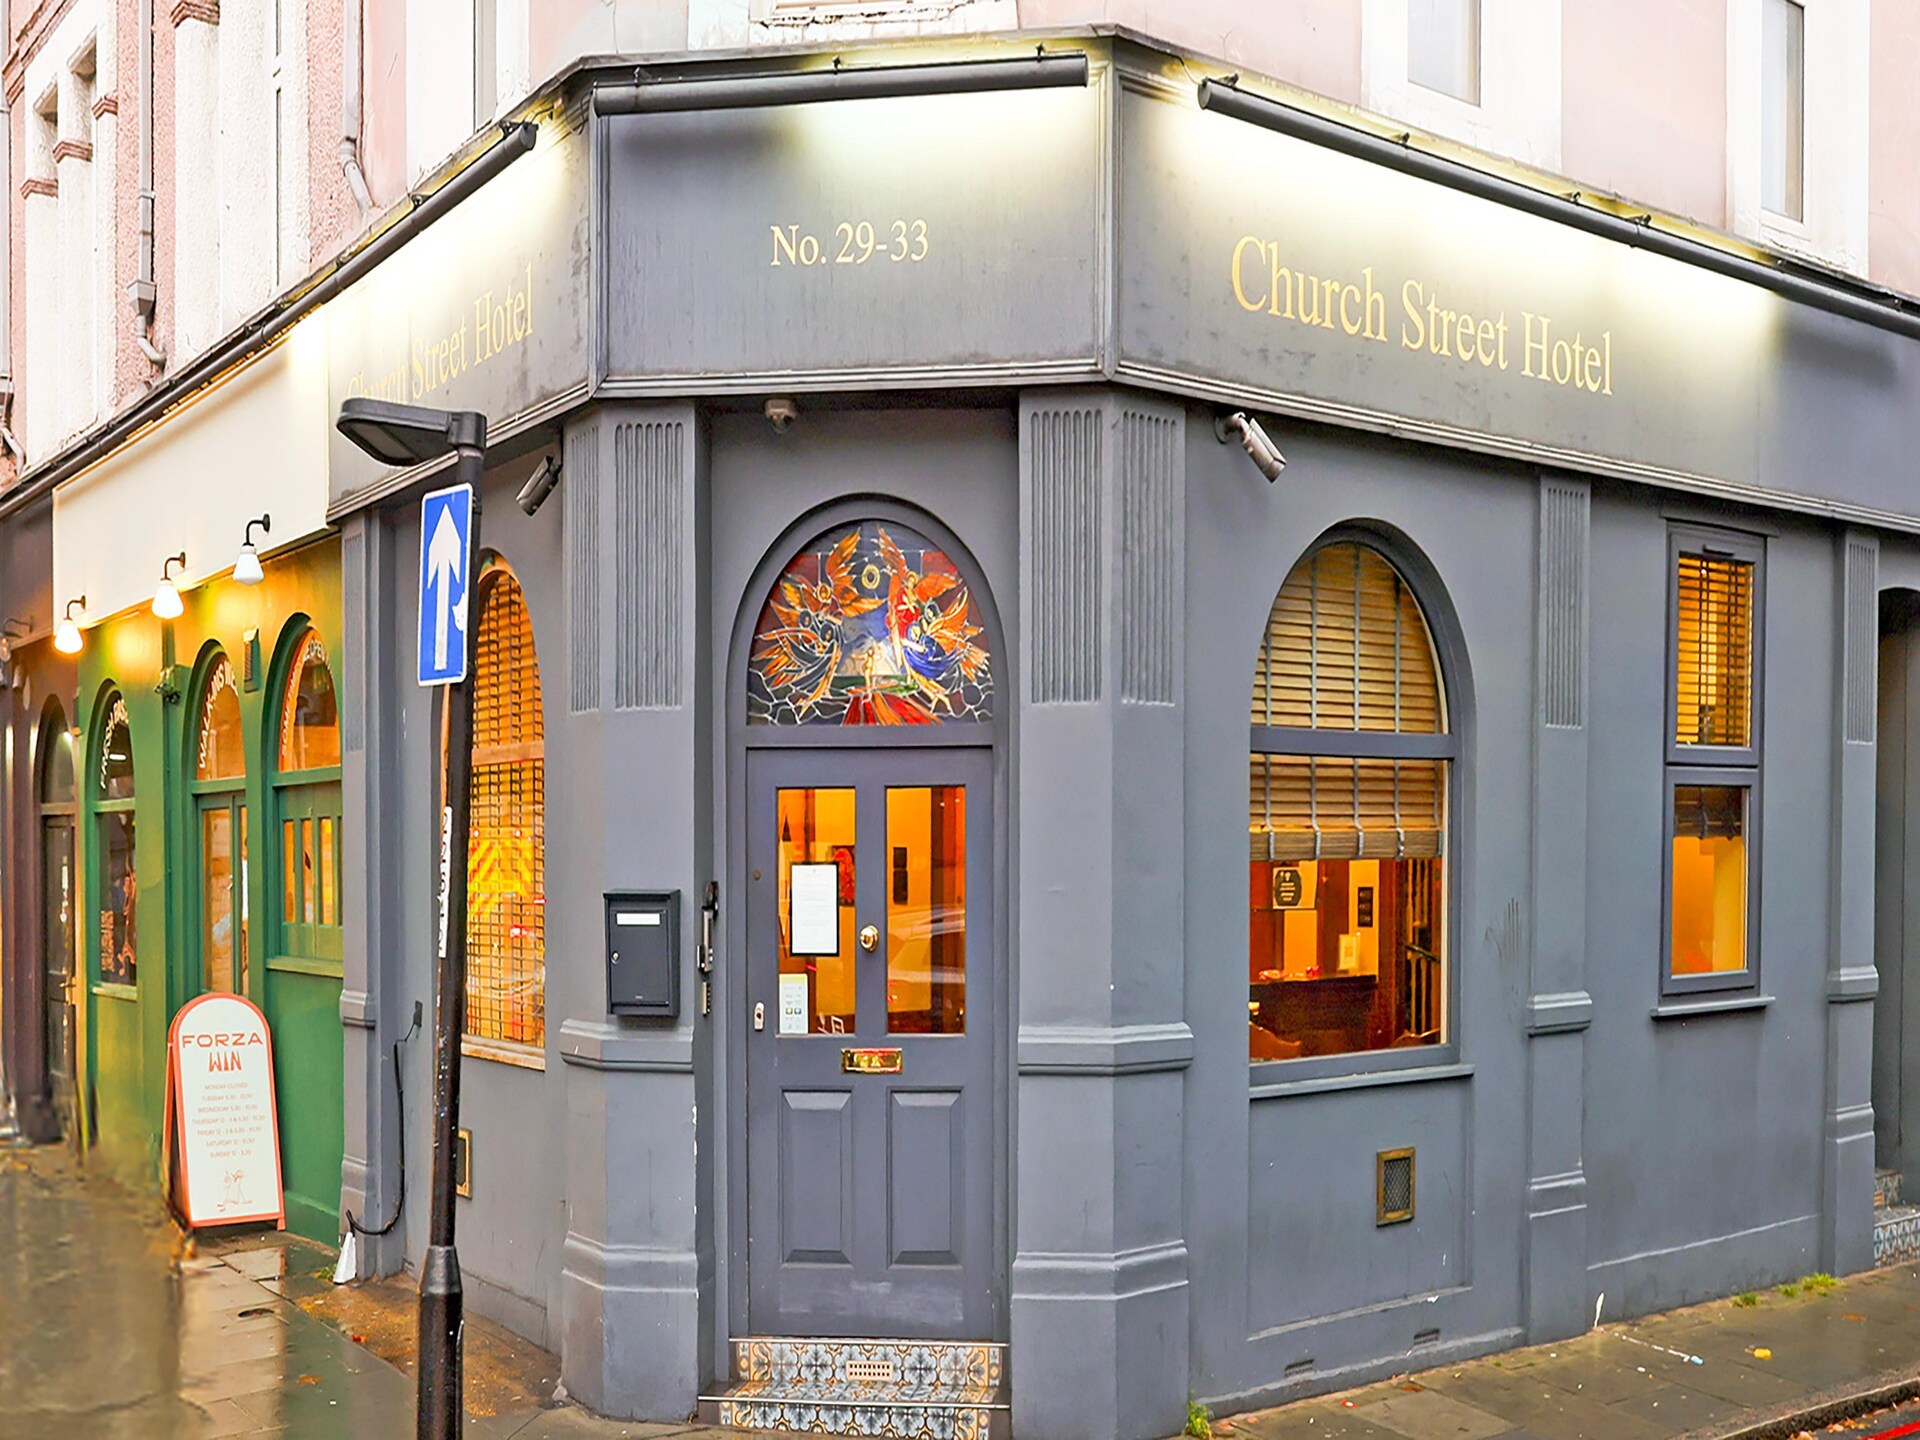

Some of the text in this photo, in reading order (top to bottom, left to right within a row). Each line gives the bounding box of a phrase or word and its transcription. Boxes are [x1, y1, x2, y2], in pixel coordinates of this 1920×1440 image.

[770, 218, 930, 266] No. 29-33
[411, 314, 468, 400] Street
[473, 261, 534, 366] Hotel
[1231, 235, 1613, 396] Church Street Hotel
[182, 1032, 263, 1048] FORZA
[209, 1051, 242, 1072] WIN
